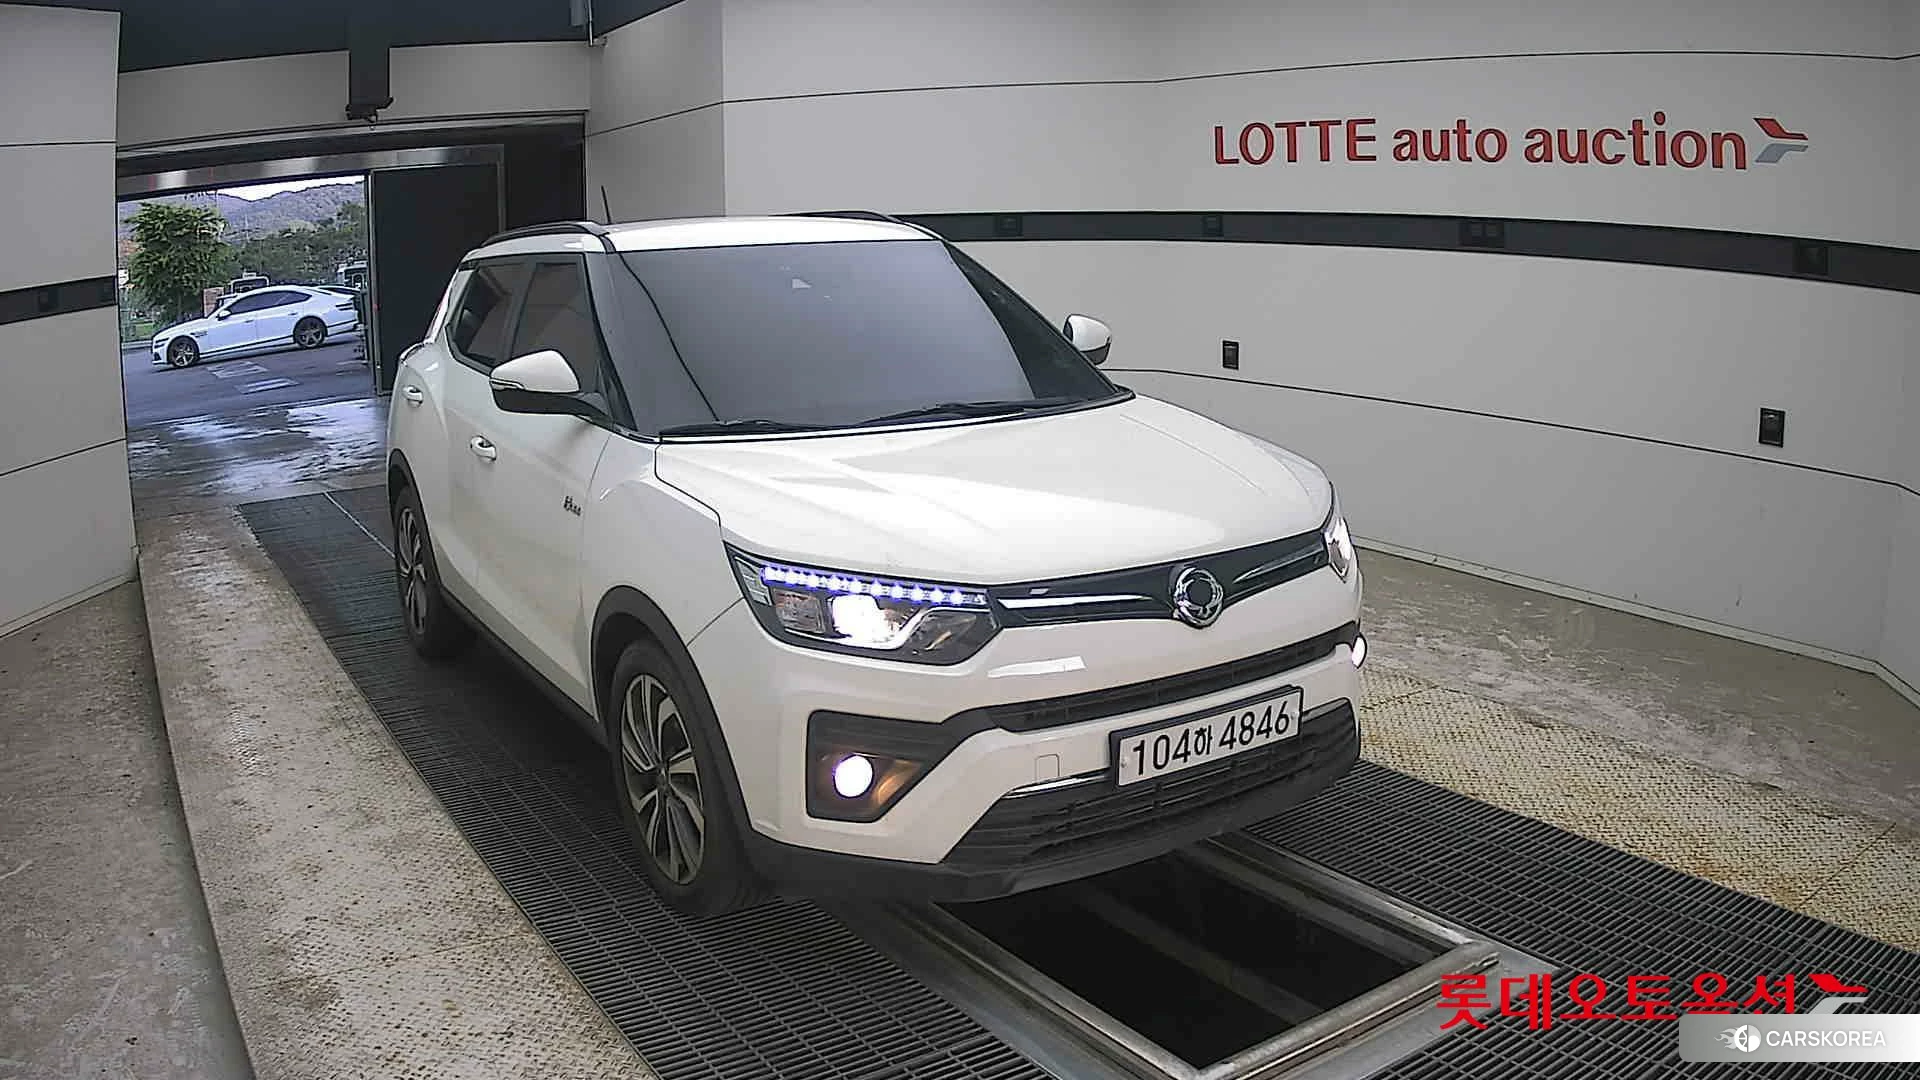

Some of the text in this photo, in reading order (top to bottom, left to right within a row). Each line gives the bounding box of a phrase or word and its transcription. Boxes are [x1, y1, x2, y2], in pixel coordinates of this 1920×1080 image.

[1214, 111, 1748, 169] LOTTE auto auction
[1133, 701, 1290, 775] 104하 4846
